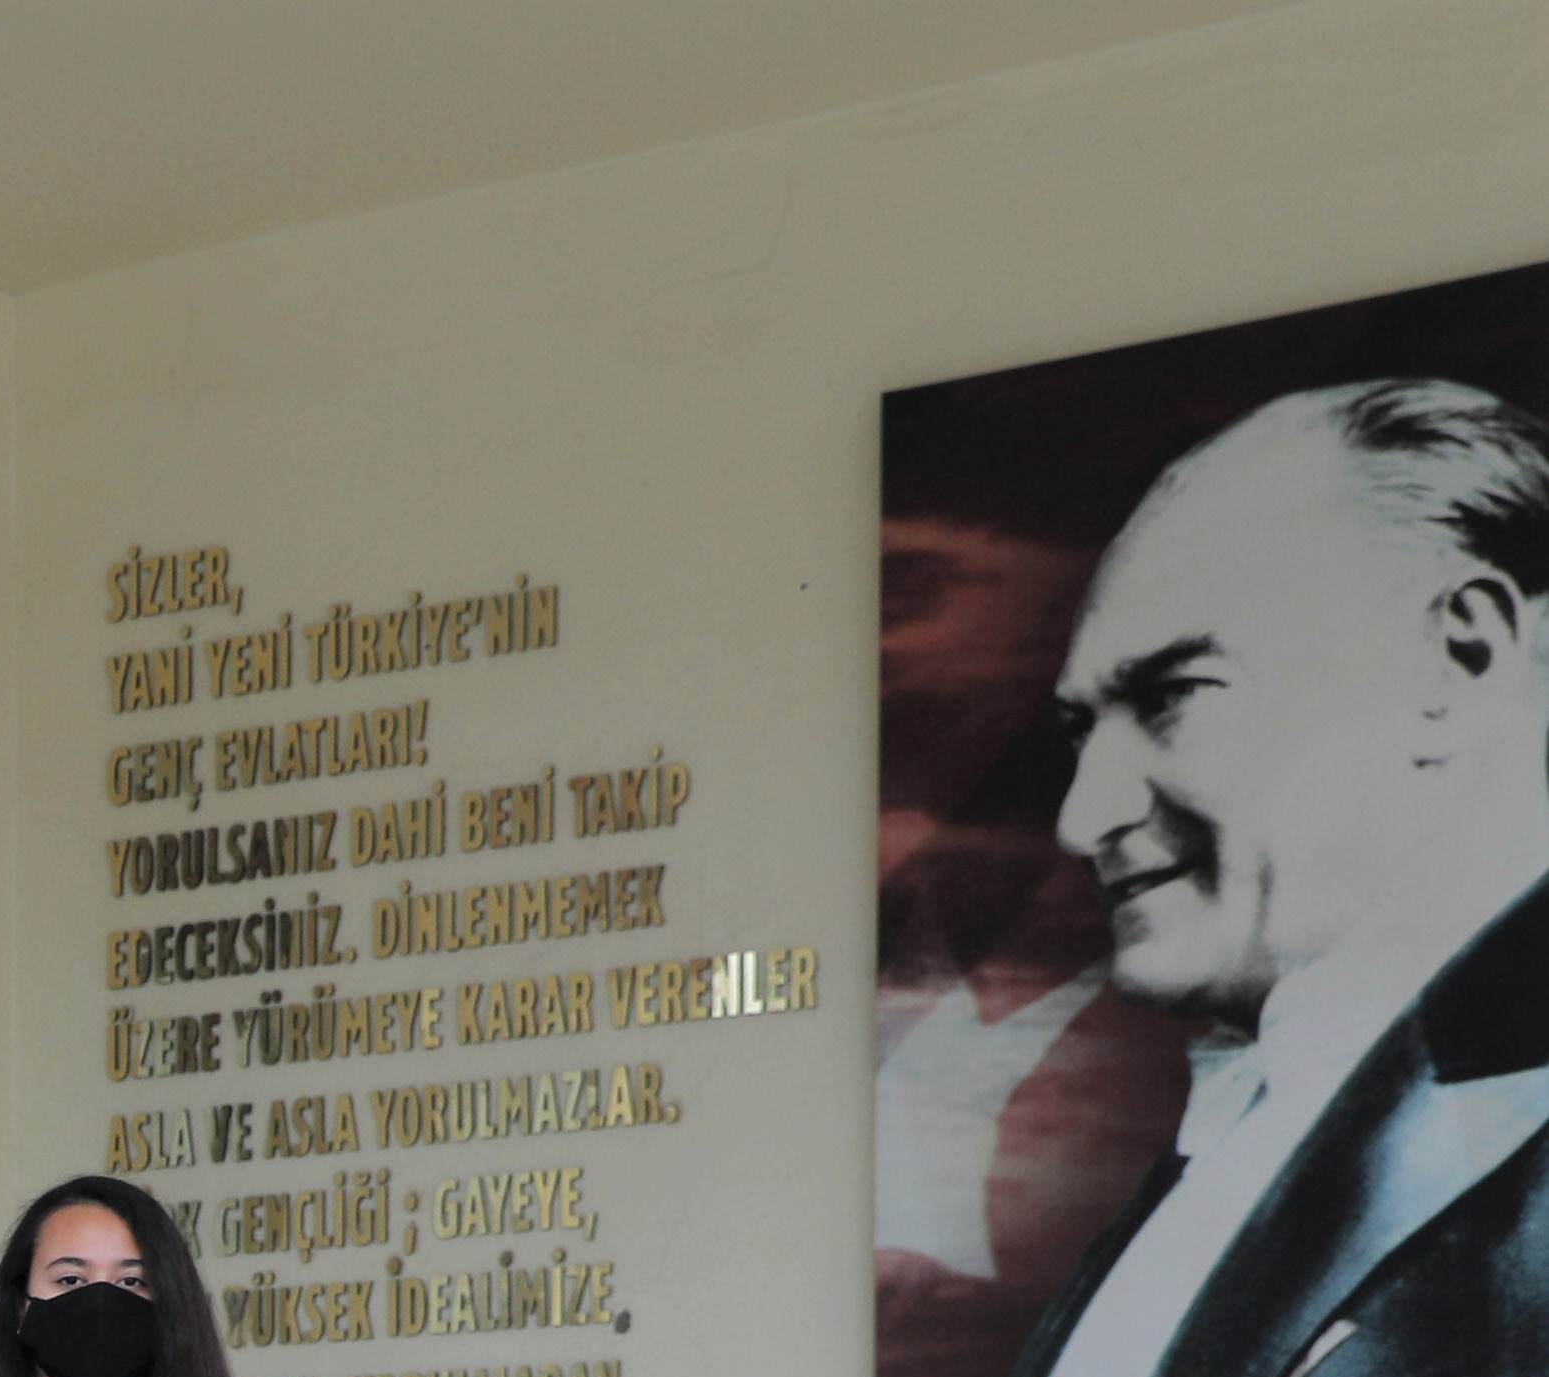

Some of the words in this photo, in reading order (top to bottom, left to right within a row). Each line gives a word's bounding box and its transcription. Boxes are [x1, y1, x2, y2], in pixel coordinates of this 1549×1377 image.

[106, 546, 242, 622] SİZLER,
[106, 625, 193, 712] YANİ
[206, 612, 293, 699] YENİ
[304, 573, 558, 686] TÜRKİYE'NİN
[107, 736, 203, 811] GENÇ
[215, 700, 429, 792] EVLATLARI!
[106, 811, 337, 897] YORULSANIZ
[352, 781, 446, 867] DAHİ
[460, 767, 557, 851] BENİ
[568, 748, 691, 837] TAKİP
[107, 892, 358, 991] EDECEKSİNİZ.
[372, 864, 667, 959] DİNLENMEMEK
[106, 1007, 222, 1083] ÜZERE
[234, 982, 444, 1072] YÜRÜMEYE
[459, 973, 594, 1045] KARAR
[608, 947, 819, 1029] VERENLER
[106, 1106, 195, 1175] ASLA
[208, 1102, 254, 1162] VE
[264, 1094, 359, 1161] ASLA
[369, 1062, 680, 1149] YORULMAZLAR.
[219, 1168, 390, 1264] GENÇLİĞİ
[433, 1167, 598, 1242] GAYEYE,
[223, 1270, 374, 1349] YÜKSEK
[386, 1249, 632, 1341] İDEALİMİZE.
